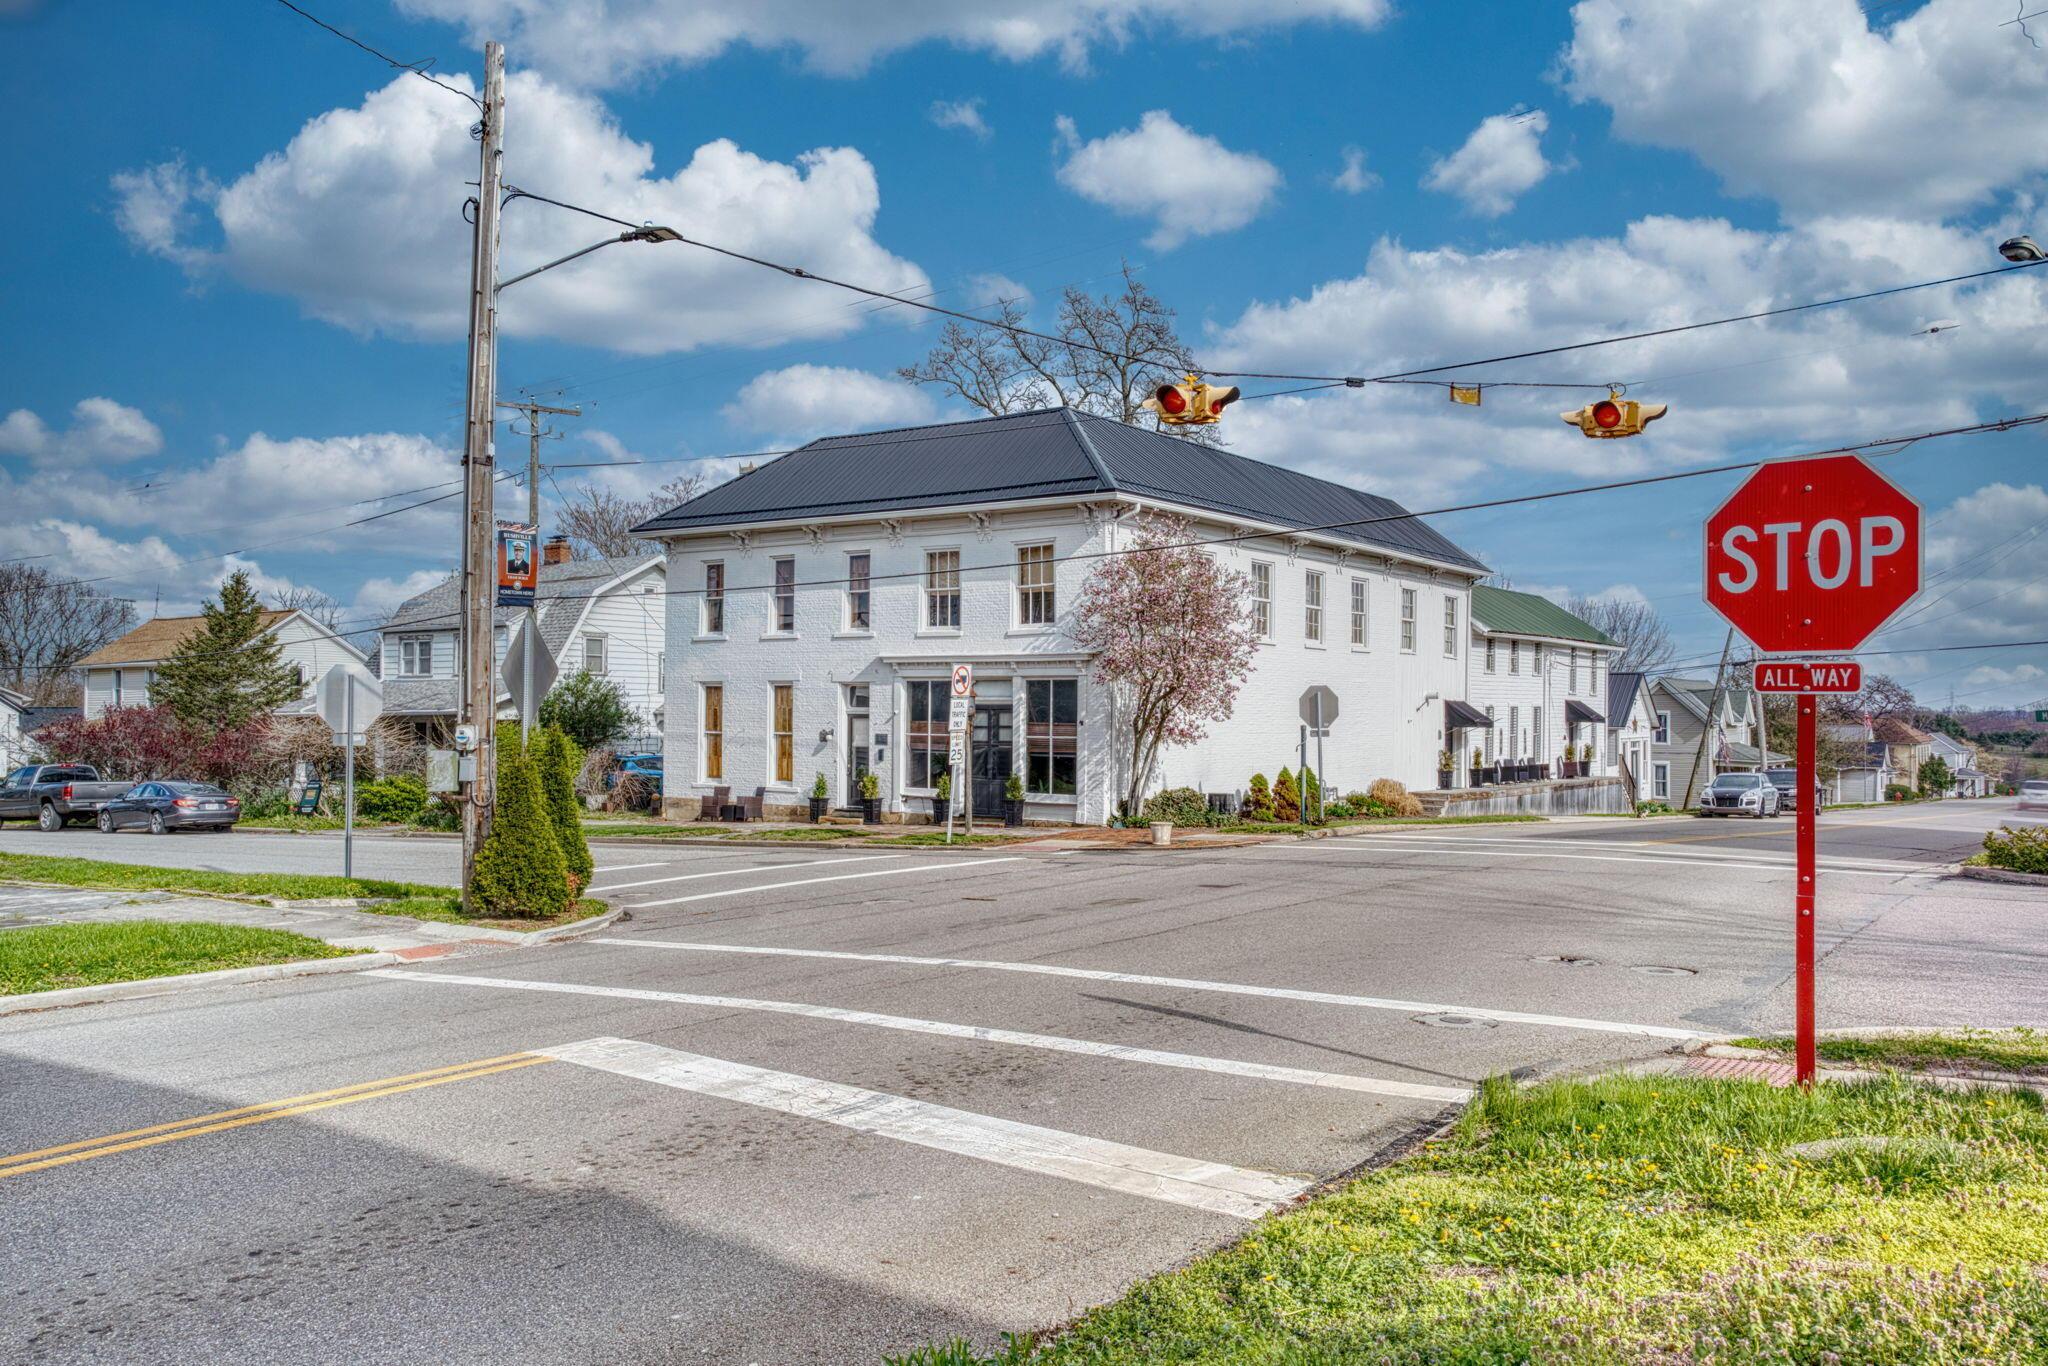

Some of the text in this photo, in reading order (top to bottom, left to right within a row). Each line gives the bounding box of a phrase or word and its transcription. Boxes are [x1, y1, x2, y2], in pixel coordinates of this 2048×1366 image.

[1718, 515, 1906, 594] STOP
[1763, 668, 1853, 687] ALL WAY
[951, 749, 963, 761] 25
